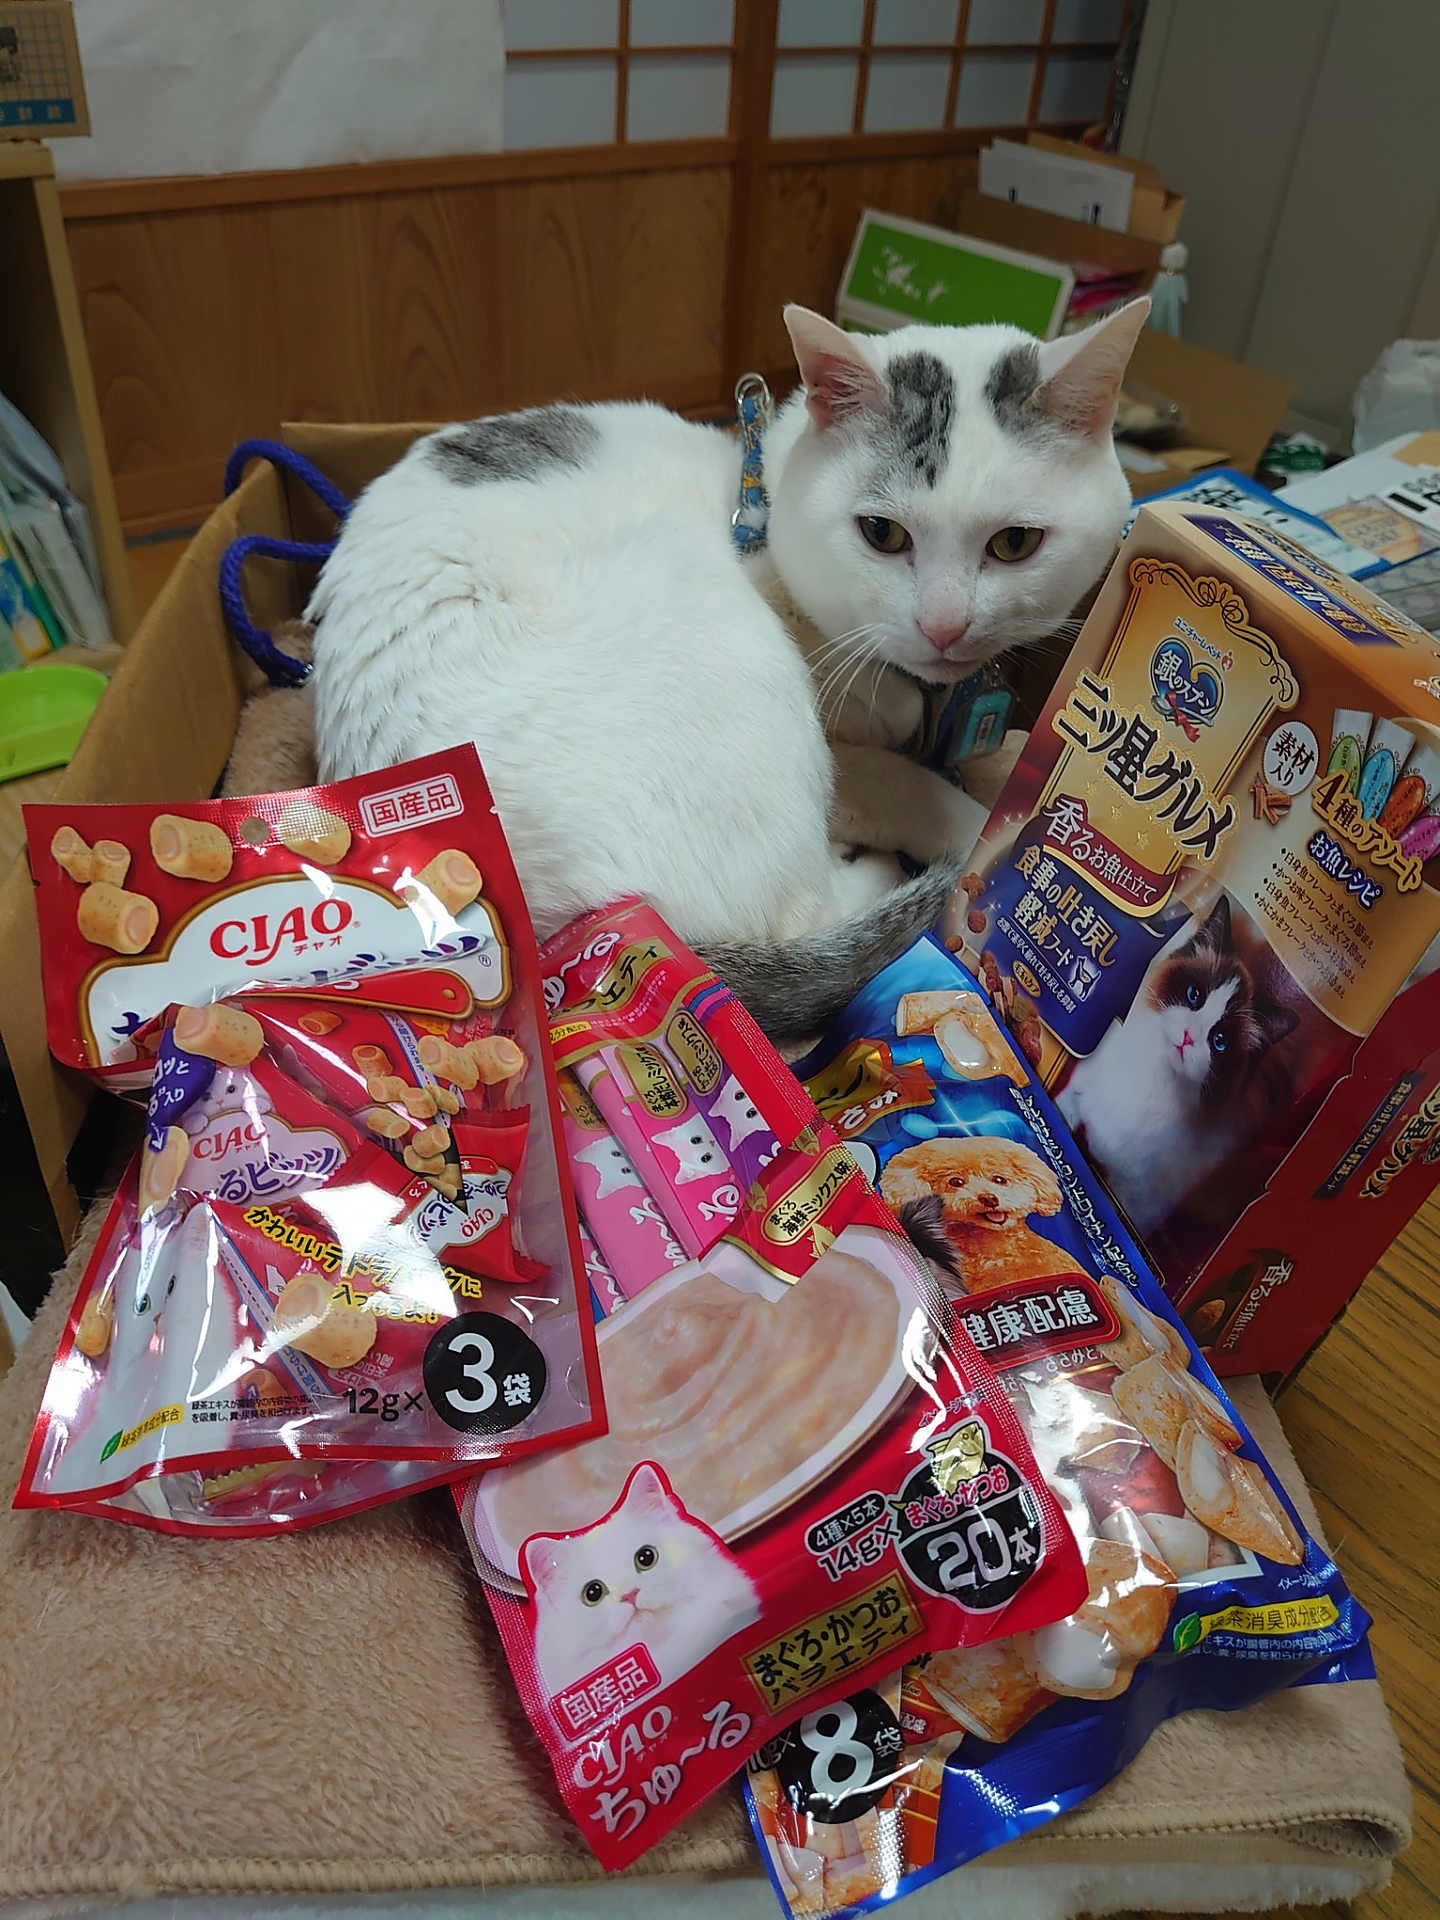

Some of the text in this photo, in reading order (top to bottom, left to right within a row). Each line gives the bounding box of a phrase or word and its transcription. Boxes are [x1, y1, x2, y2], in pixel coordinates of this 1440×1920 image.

[1153, 648, 1218, 717] 銀のスプーン
[1062, 675, 1234, 858] 三ツ星グルメ
[1269, 761, 1294, 786] 入り
[1272, 729, 1315, 776] 素材
[370, 784, 457, 827] 国産品
[1316, 773, 1422, 886] 4種のアソート
[1041, 799, 1157, 903] 香るお魚仕立て
[1310, 833, 1382, 905] お魚レシピ
[209, 899, 353, 966] CIAO
[1010, 890, 1077, 966] 軽減フード
[1014, 846, 1116, 966] 食事の吐き戻し
[294, 935, 343, 956] チャオ
[643, 1089, 664, 1113] まぐろ
[461, 1208, 495, 1238] CIAO
[770, 1202, 797, 1226] まぐろ
[961, 1289, 1098, 1350] 健康配慮
[815, 1499, 882, 1546] 4種×5本
[751, 1586, 901, 1687] まぐろ・かつお
[772, 1619, 911, 1705] バラエティ
[560, 1658, 648, 1730] 国産品
[572, 1705, 674, 1789] CIAO
